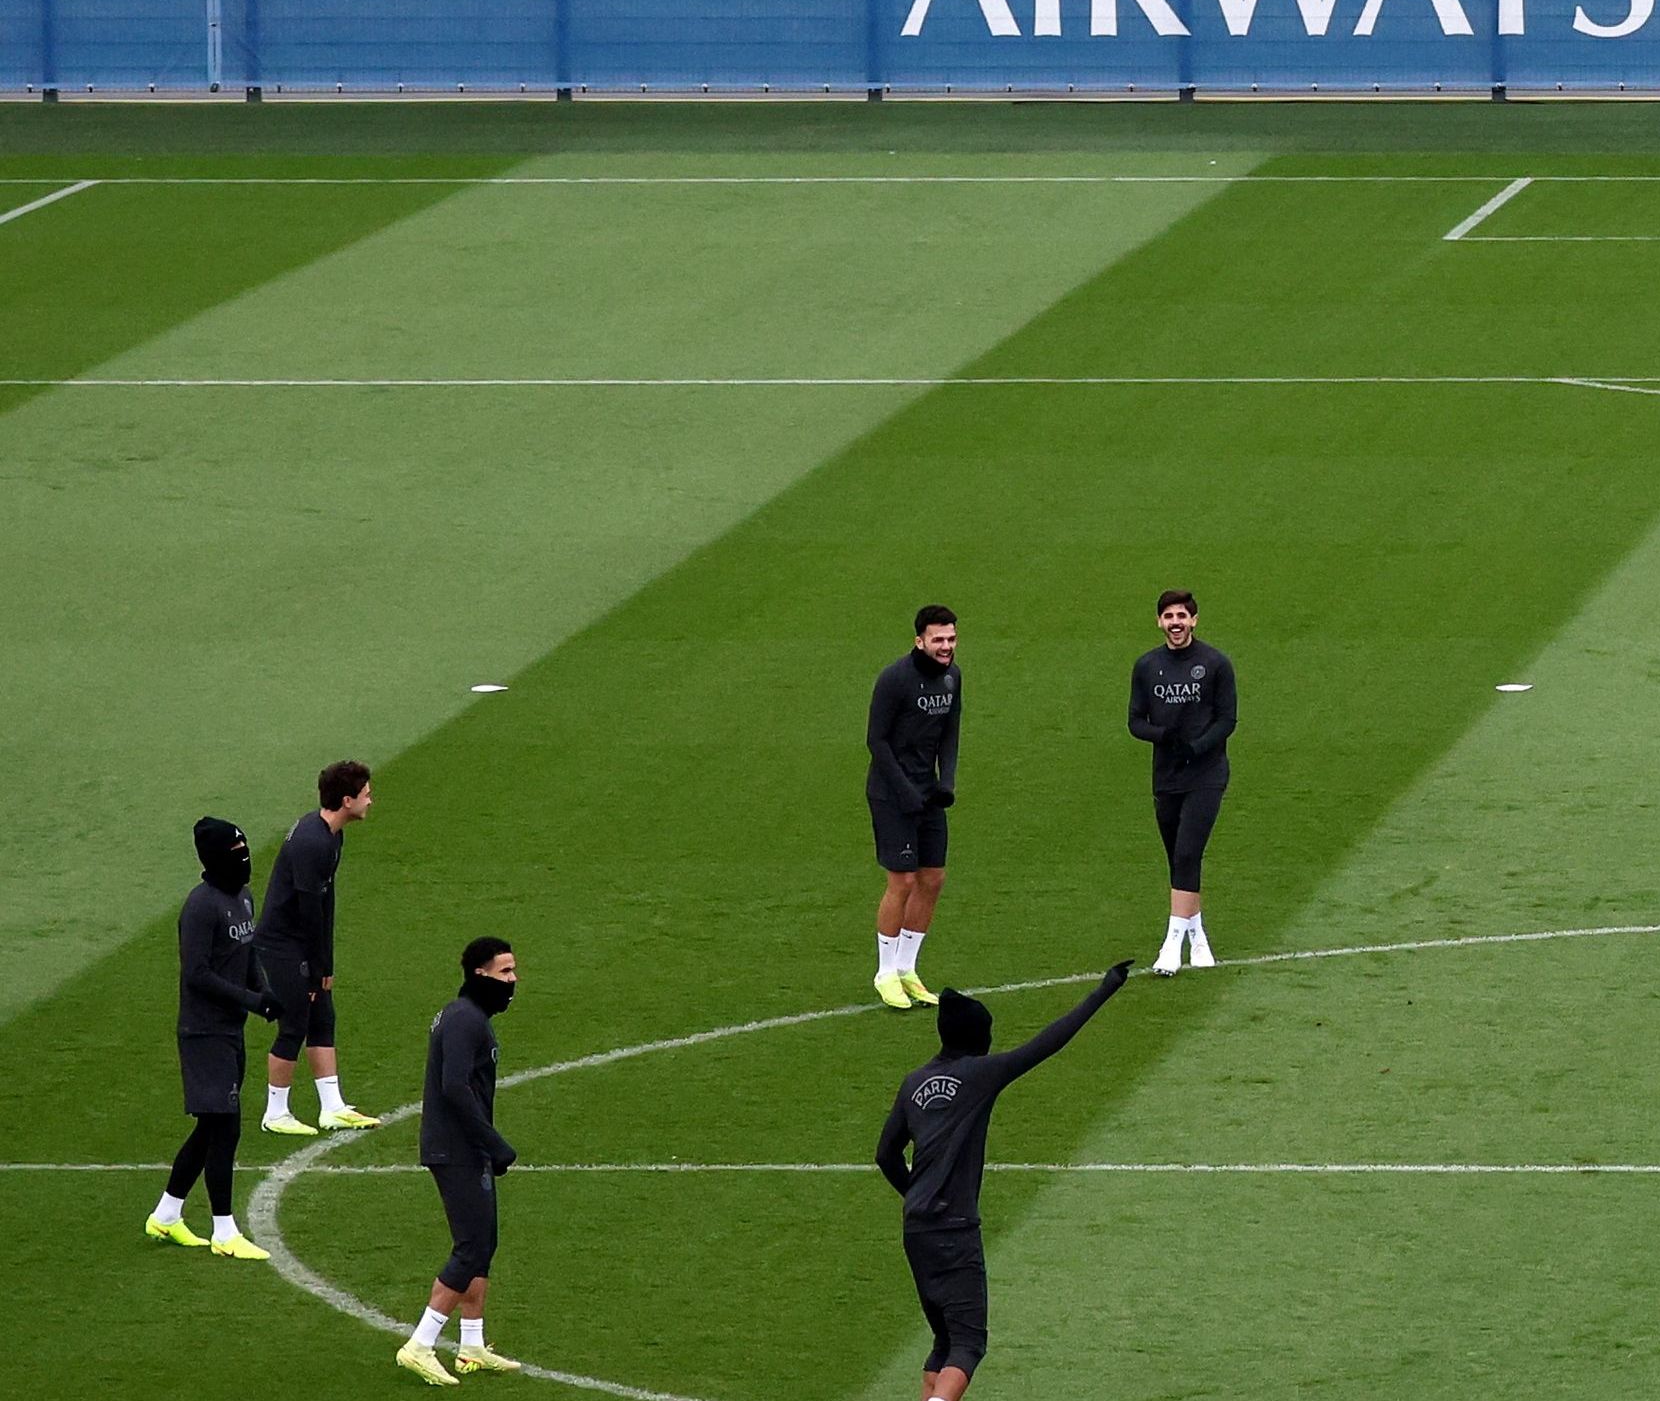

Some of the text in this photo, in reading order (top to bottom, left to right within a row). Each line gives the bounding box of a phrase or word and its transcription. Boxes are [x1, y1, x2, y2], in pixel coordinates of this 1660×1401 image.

[1153, 682, 1201, 700] QATAR
[1165, 694, 1201, 704] AIRWAYS
[913, 1079, 959, 1107] PARIS
